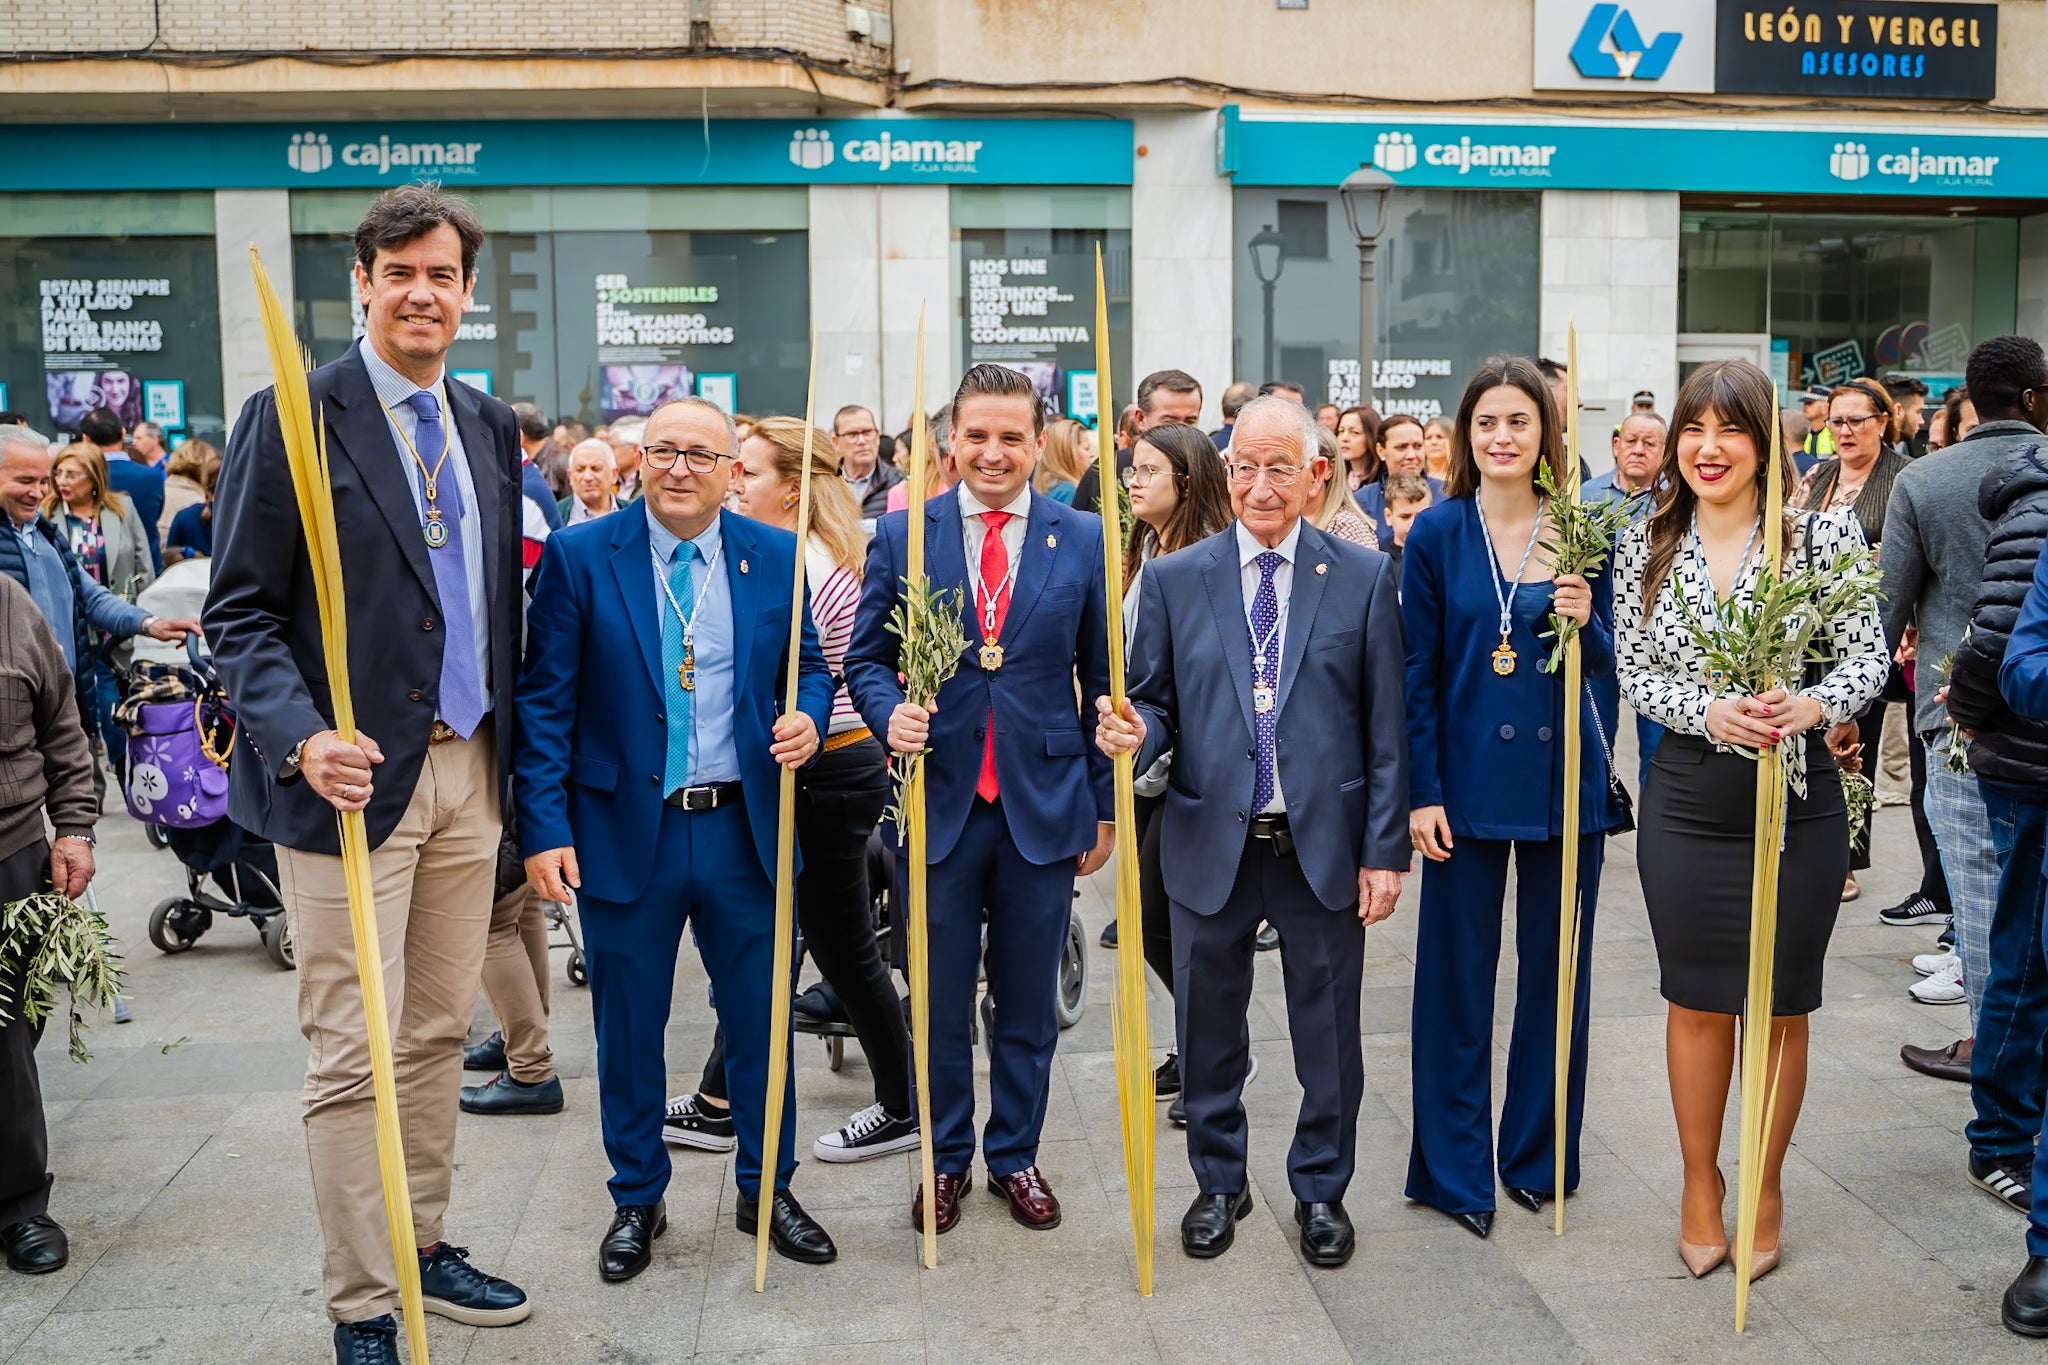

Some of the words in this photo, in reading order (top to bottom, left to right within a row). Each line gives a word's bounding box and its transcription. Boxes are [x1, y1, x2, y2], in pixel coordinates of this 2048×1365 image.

[1744, 5, 1822, 43] LEÓN
[1836, 14, 1855, 44] Y
[1868, 15, 1981, 48] VERGEL
[1801, 50, 1926, 78] ASESORES
[341, 134, 482, 175] cajamar
[842, 131, 983, 172] cajamar
[1424, 136, 1557, 175] cajamar
[1877, 146, 2000, 184] cajamar
[970, 259, 1008, 275] NOS
[1011, 259, 1047, 275] UNE
[40, 280, 94, 296] ESTAR
[96, 279, 170, 296] SIEMPRE
[595, 274, 628, 290] SER
[970, 275, 1002, 288] SER
[41, 296, 55, 310] A
[57, 296, 80, 310] TU
[84, 295, 133, 310] LADO
[971, 301, 1009, 316] NOS
[1011, 301, 1048, 316] UNE
[42, 309, 92, 323] PARA
[597, 313, 707, 330] EMPEZANDO
[971, 315, 1003, 329] SER
[42, 322, 99, 337] HACER
[101, 321, 163, 336] BANCA
[597, 329, 636, 345] POR
[637, 327, 734, 345] NOSOTROS
[971, 327, 1090, 343] COOPERATIVA
[43, 336, 67, 351] DE
[69, 335, 162, 351] PERSONAS
[1382, 360, 1451, 375] SIEMPRE
[1328, 374, 1343, 387] A
[1372, 374, 1416, 389] LADO
[1385, 399, 1442, 415] BANCA
